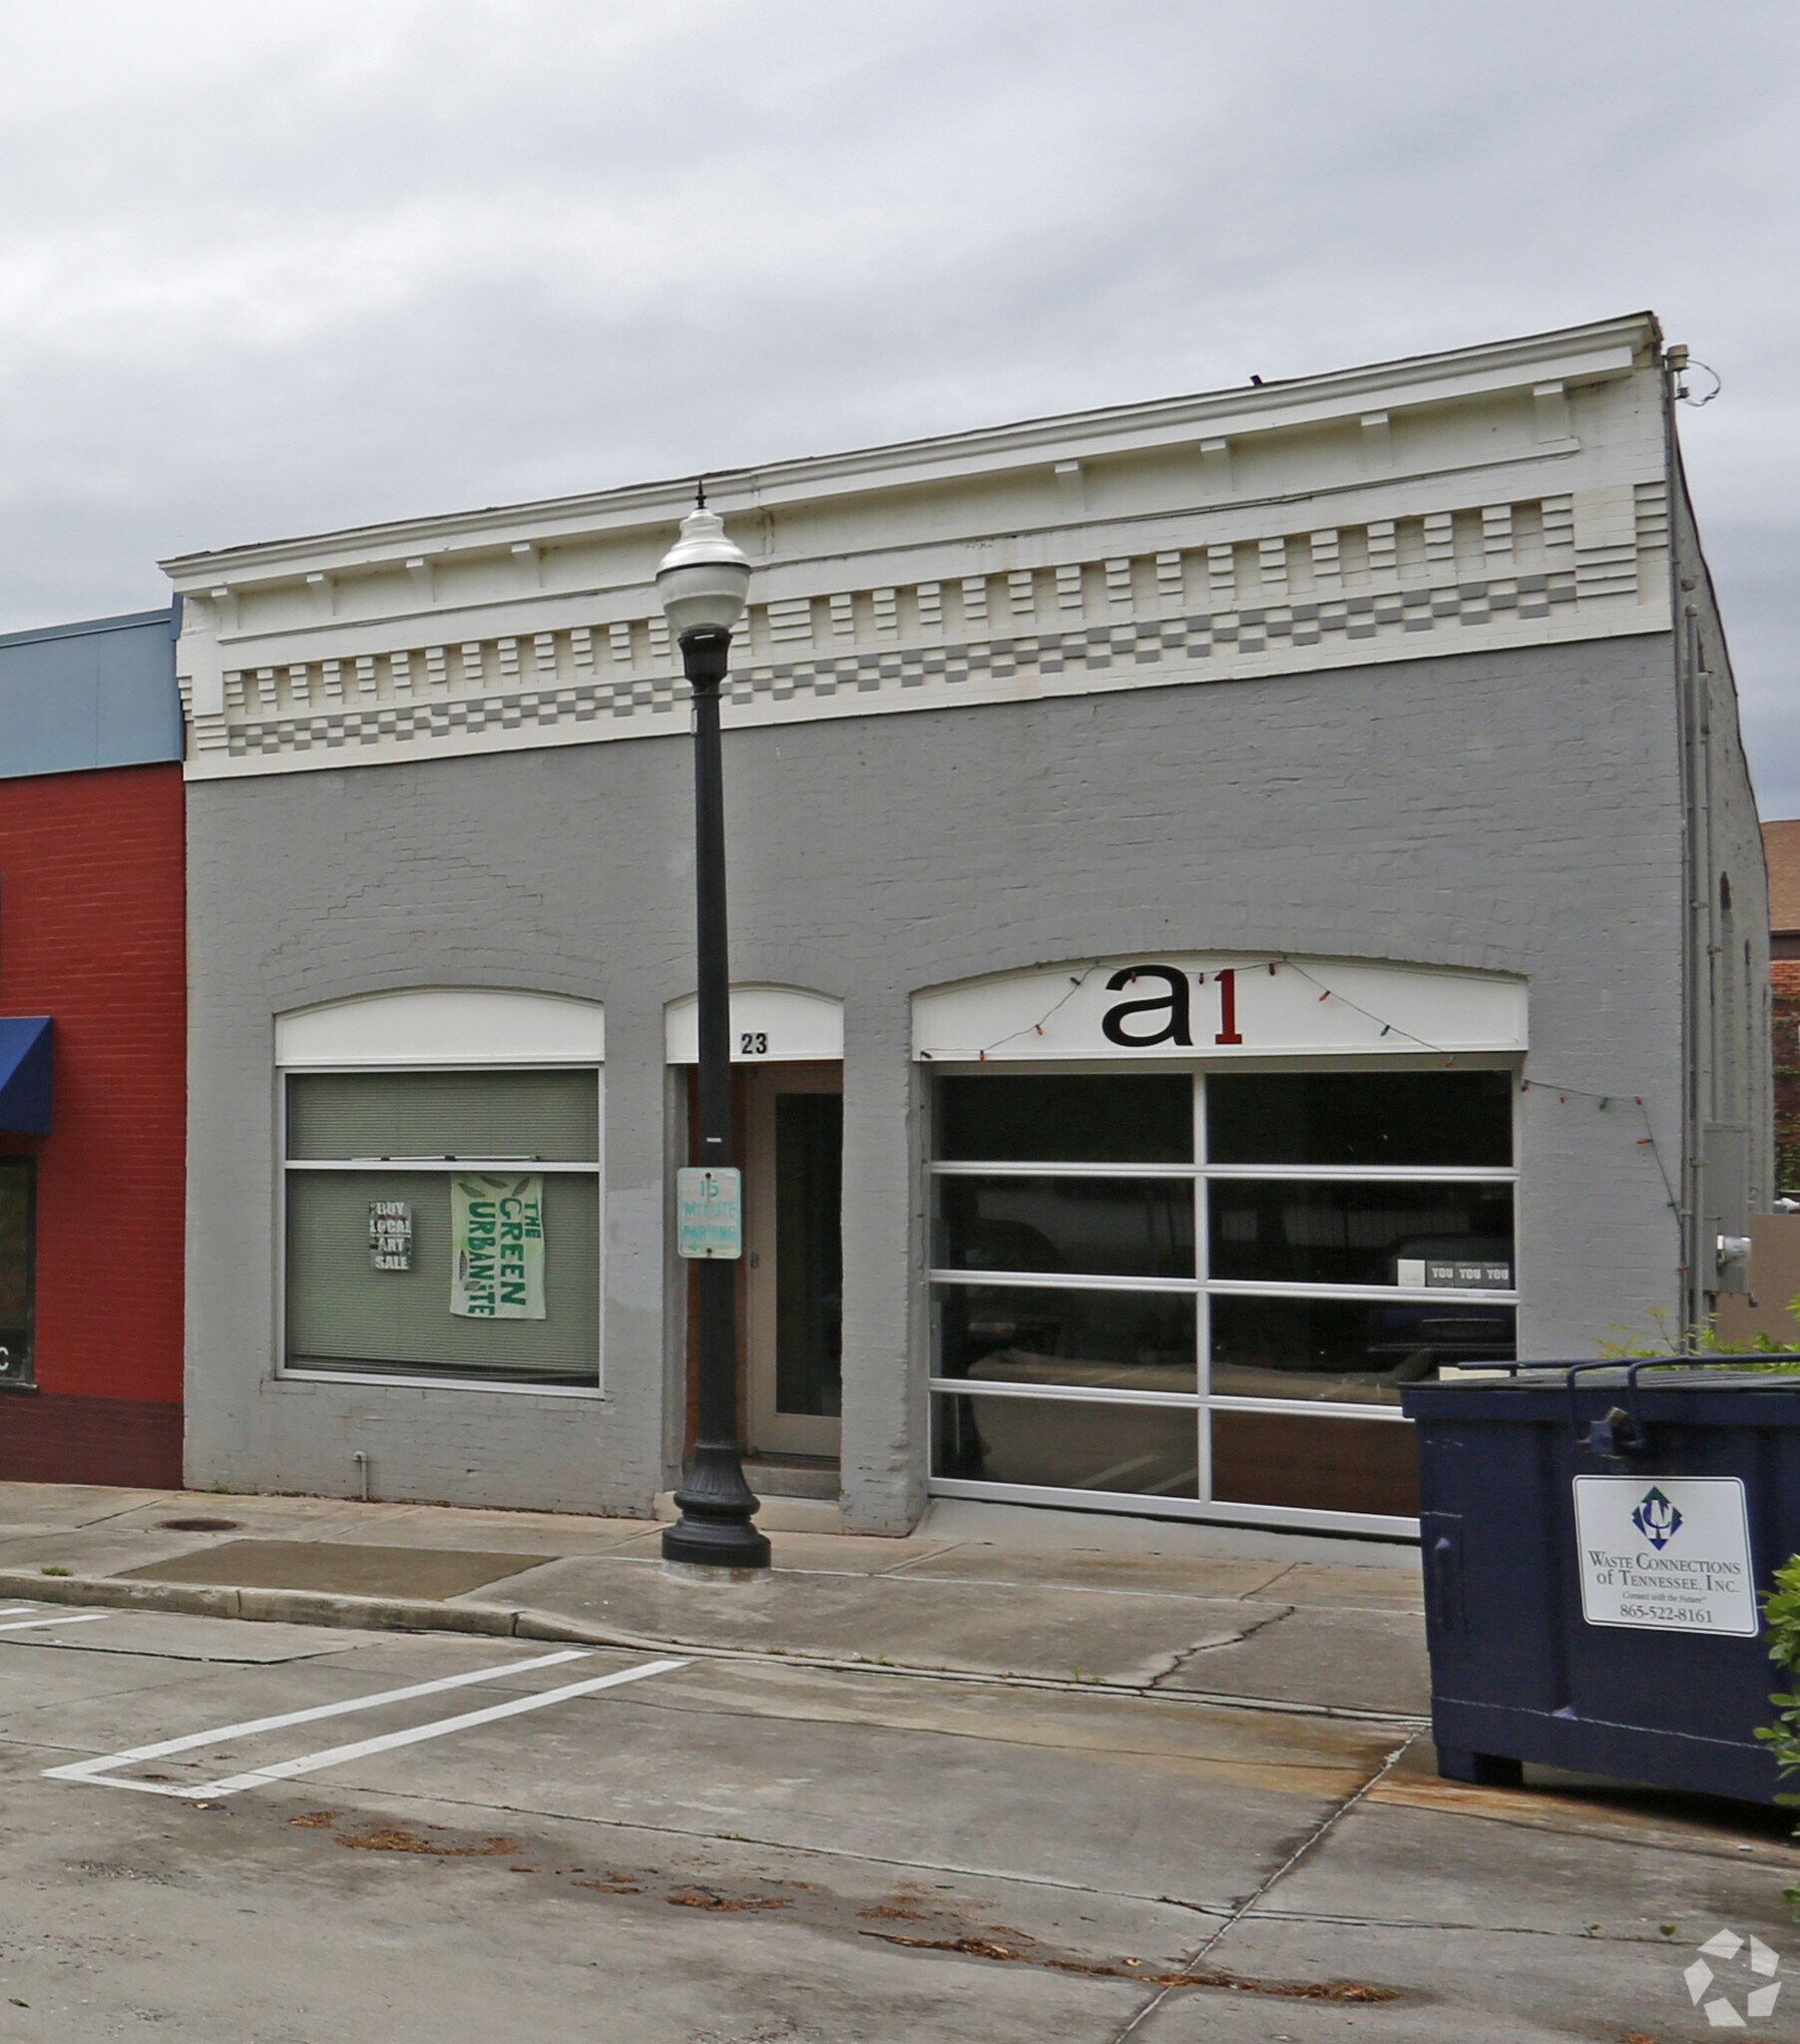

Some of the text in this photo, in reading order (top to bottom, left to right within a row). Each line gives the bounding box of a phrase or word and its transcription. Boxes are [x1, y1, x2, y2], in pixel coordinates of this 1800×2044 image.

[741, 1032, 767, 1054] 23
[700, 1179, 719, 1197] 15
[376, 1202, 404, 1215] BUY
[369, 1220, 411, 1233] LOCAL
[524, 1199, 541, 1239] THE
[378, 1239, 404, 1251] ART
[500, 1198, 526, 1305] GREEN
[375, 1256, 409, 1270] SALE
[1432, 1268, 1510, 1280] YOU YOU YOU
[1596, 1570, 1614, 1585] of
[1620, 1604, 1713, 1623] 865-522-8161
